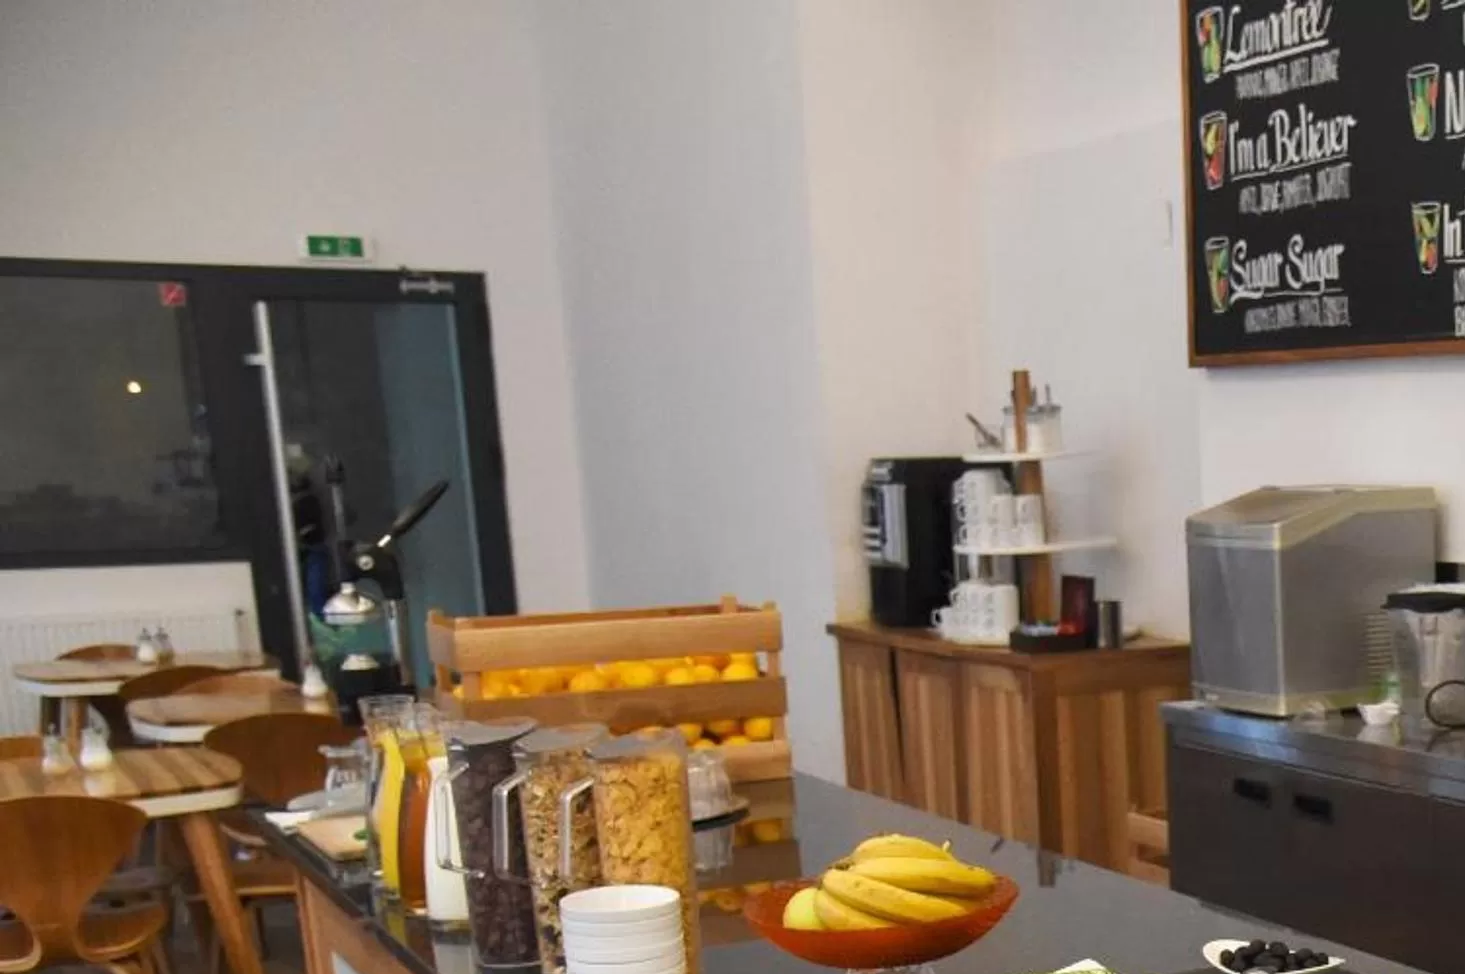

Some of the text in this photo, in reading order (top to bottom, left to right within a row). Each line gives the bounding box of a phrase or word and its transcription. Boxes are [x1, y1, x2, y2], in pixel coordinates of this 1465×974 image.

[1443, 203, 1464, 257] In
[1229, 233, 1345, 305] Sugar Sugar
